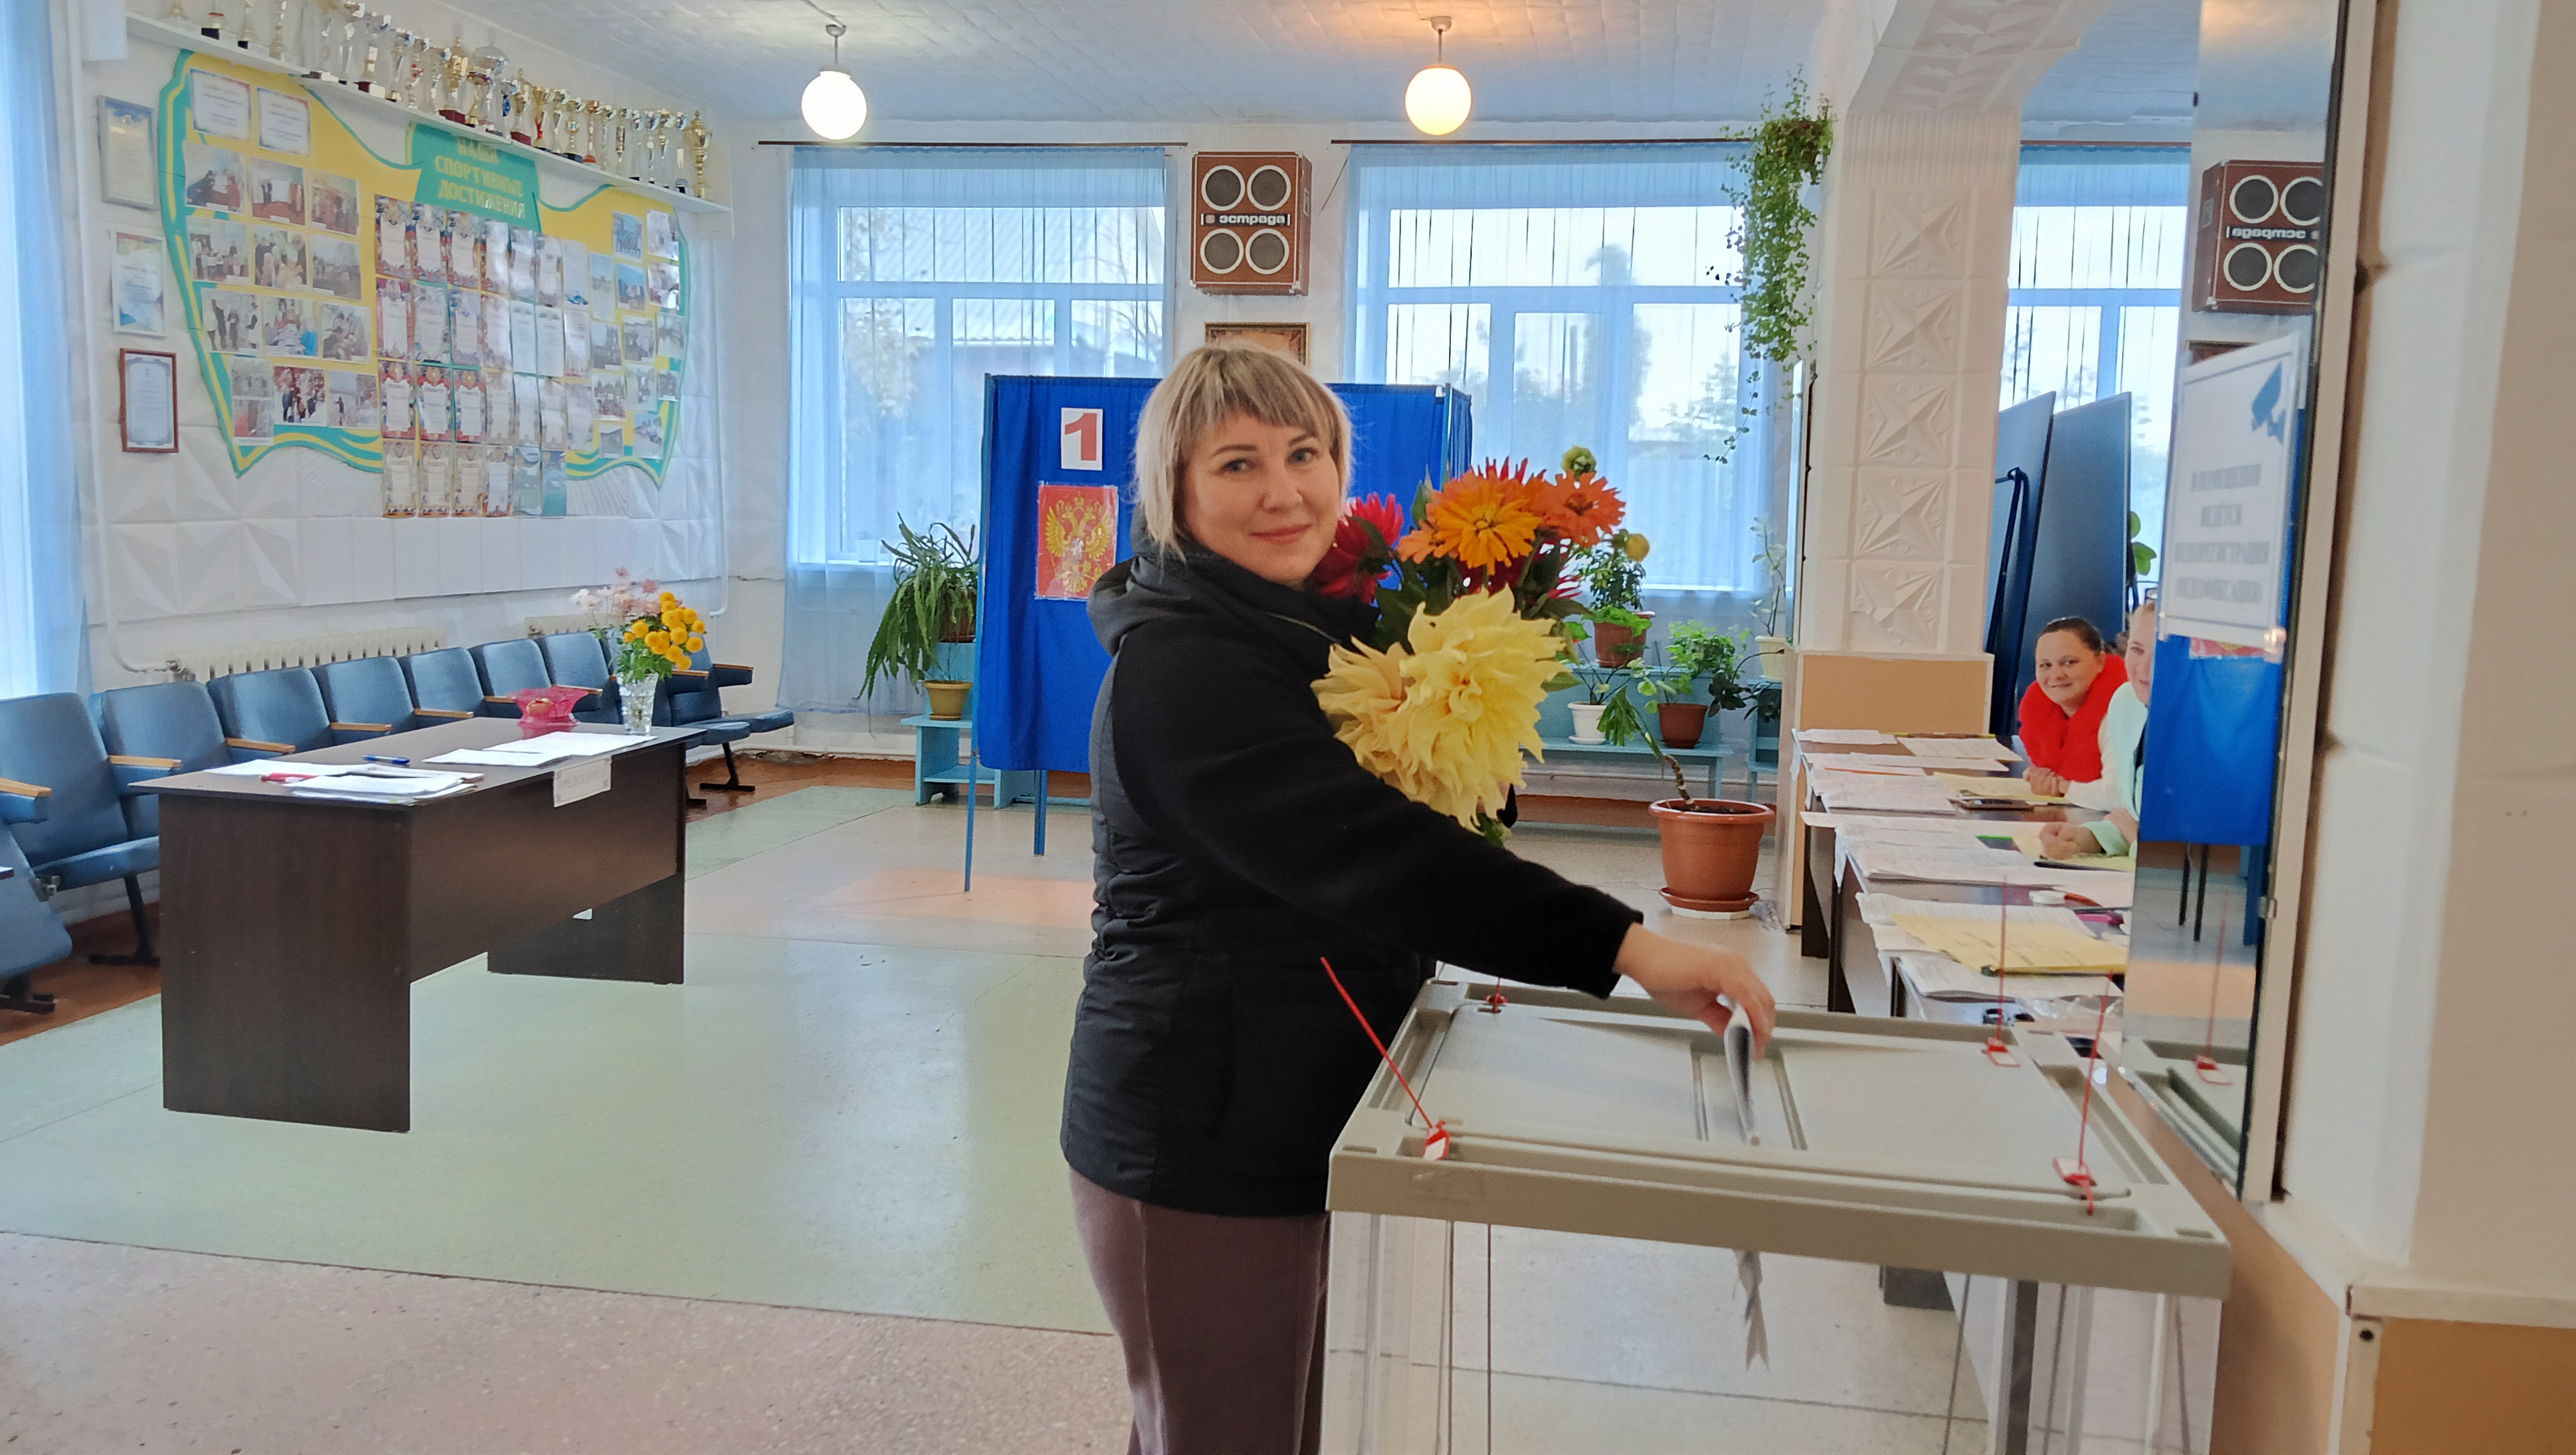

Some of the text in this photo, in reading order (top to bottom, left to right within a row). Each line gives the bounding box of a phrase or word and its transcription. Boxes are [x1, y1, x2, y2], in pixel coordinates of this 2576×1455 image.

[435, 155, 523, 197] СПОРТИВНЫЕ
[438, 179, 525, 219] ДОСТИЖЕНИЯ
[1064, 412, 1097, 461] 1
